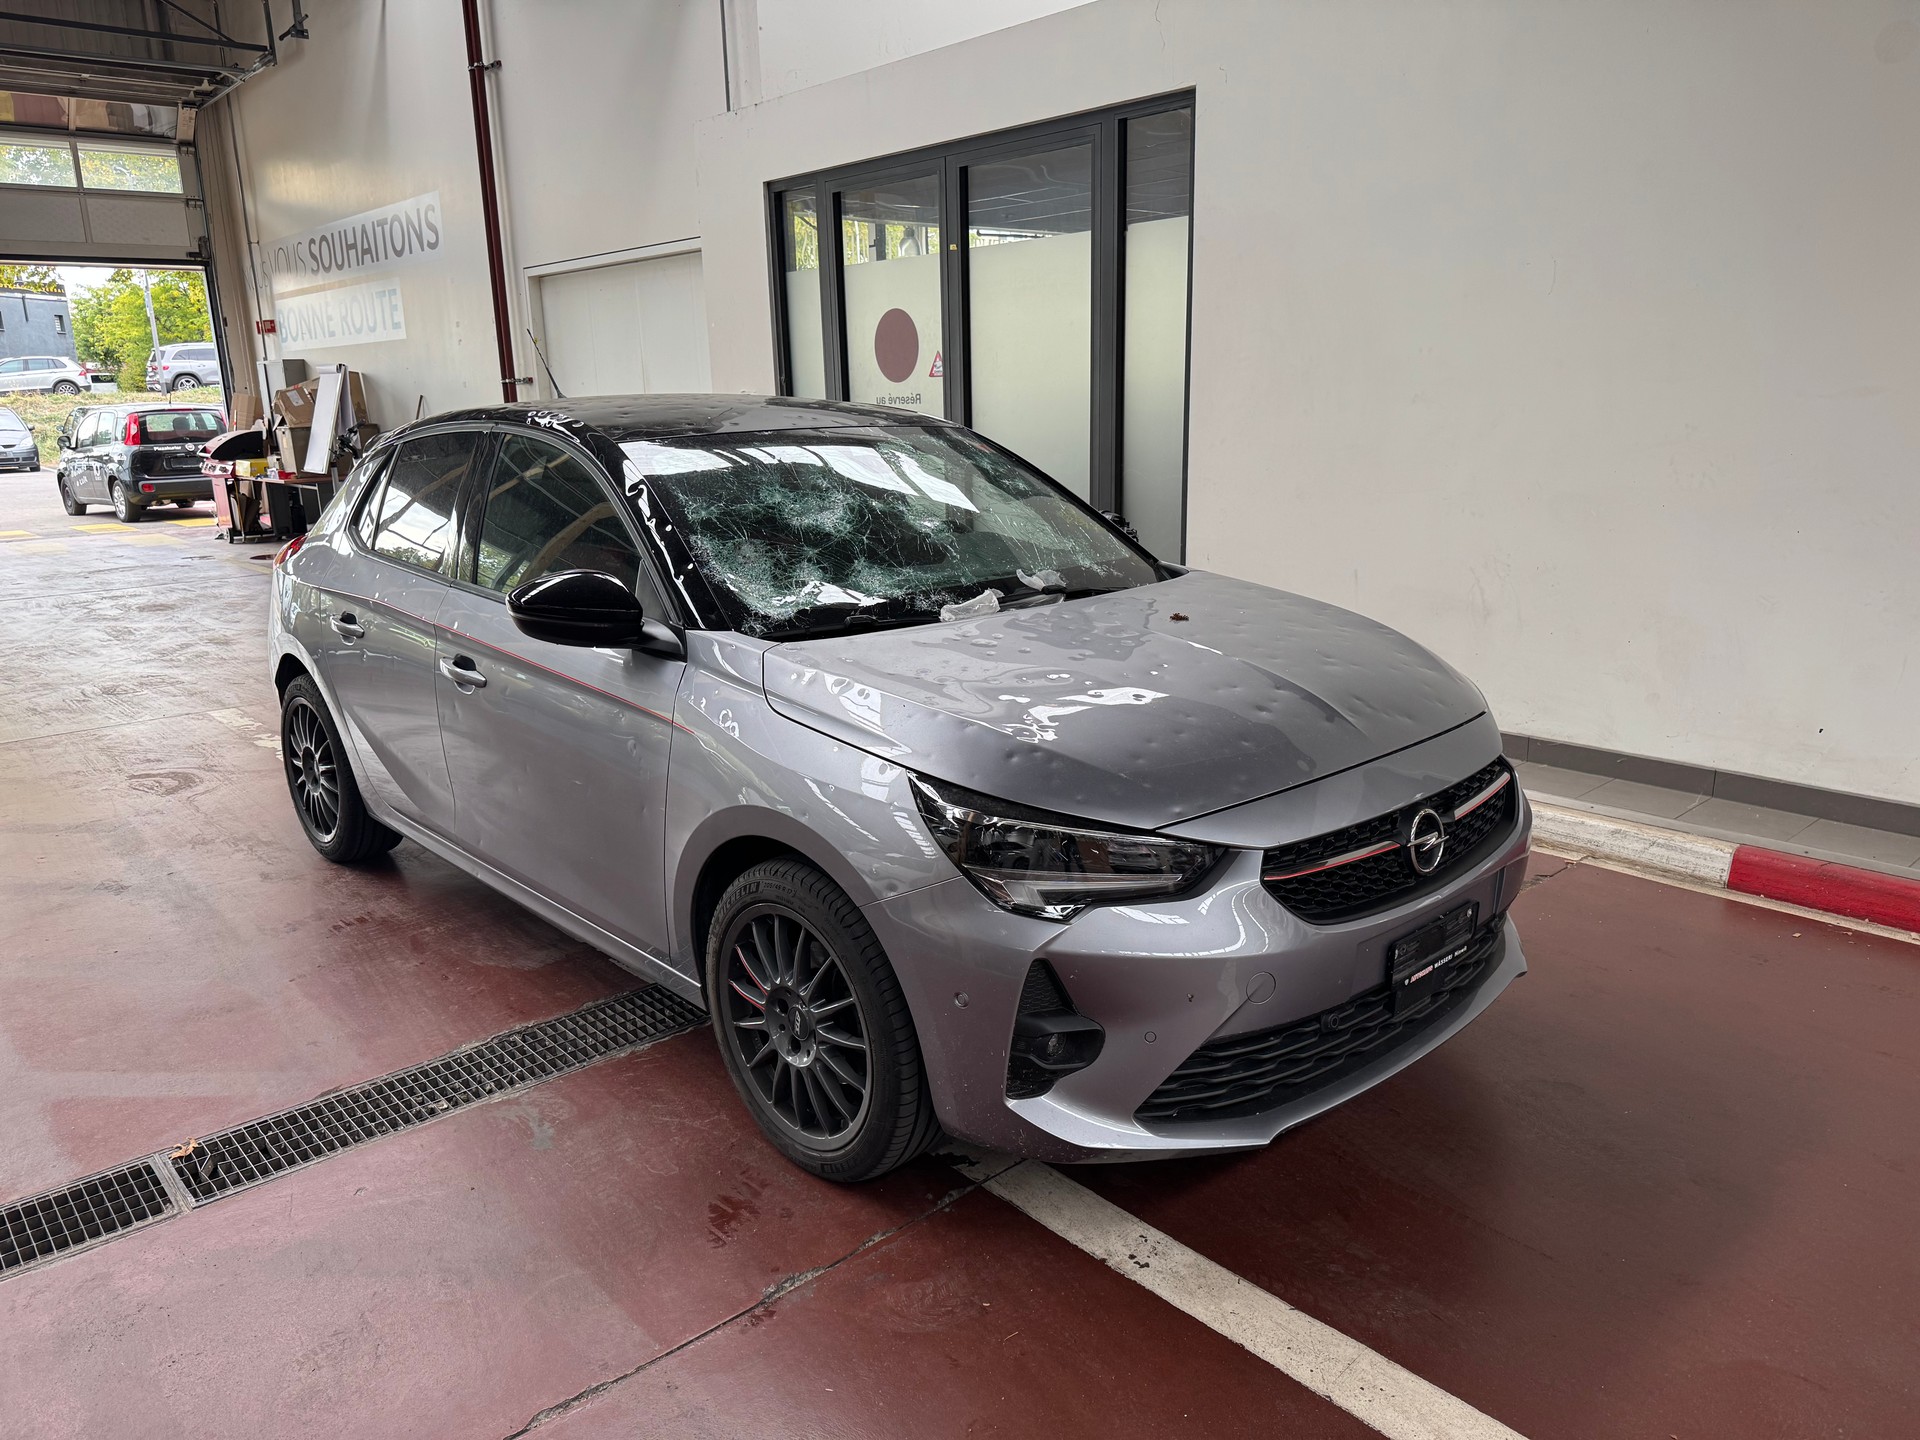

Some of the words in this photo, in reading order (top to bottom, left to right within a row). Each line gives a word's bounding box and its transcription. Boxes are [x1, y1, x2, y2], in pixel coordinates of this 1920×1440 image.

[267, 241, 307, 277] VOUS
[308, 204, 440, 276] SOUHAITONS
[278, 299, 336, 344] BONNE
[338, 288, 402, 337] ROUTE
